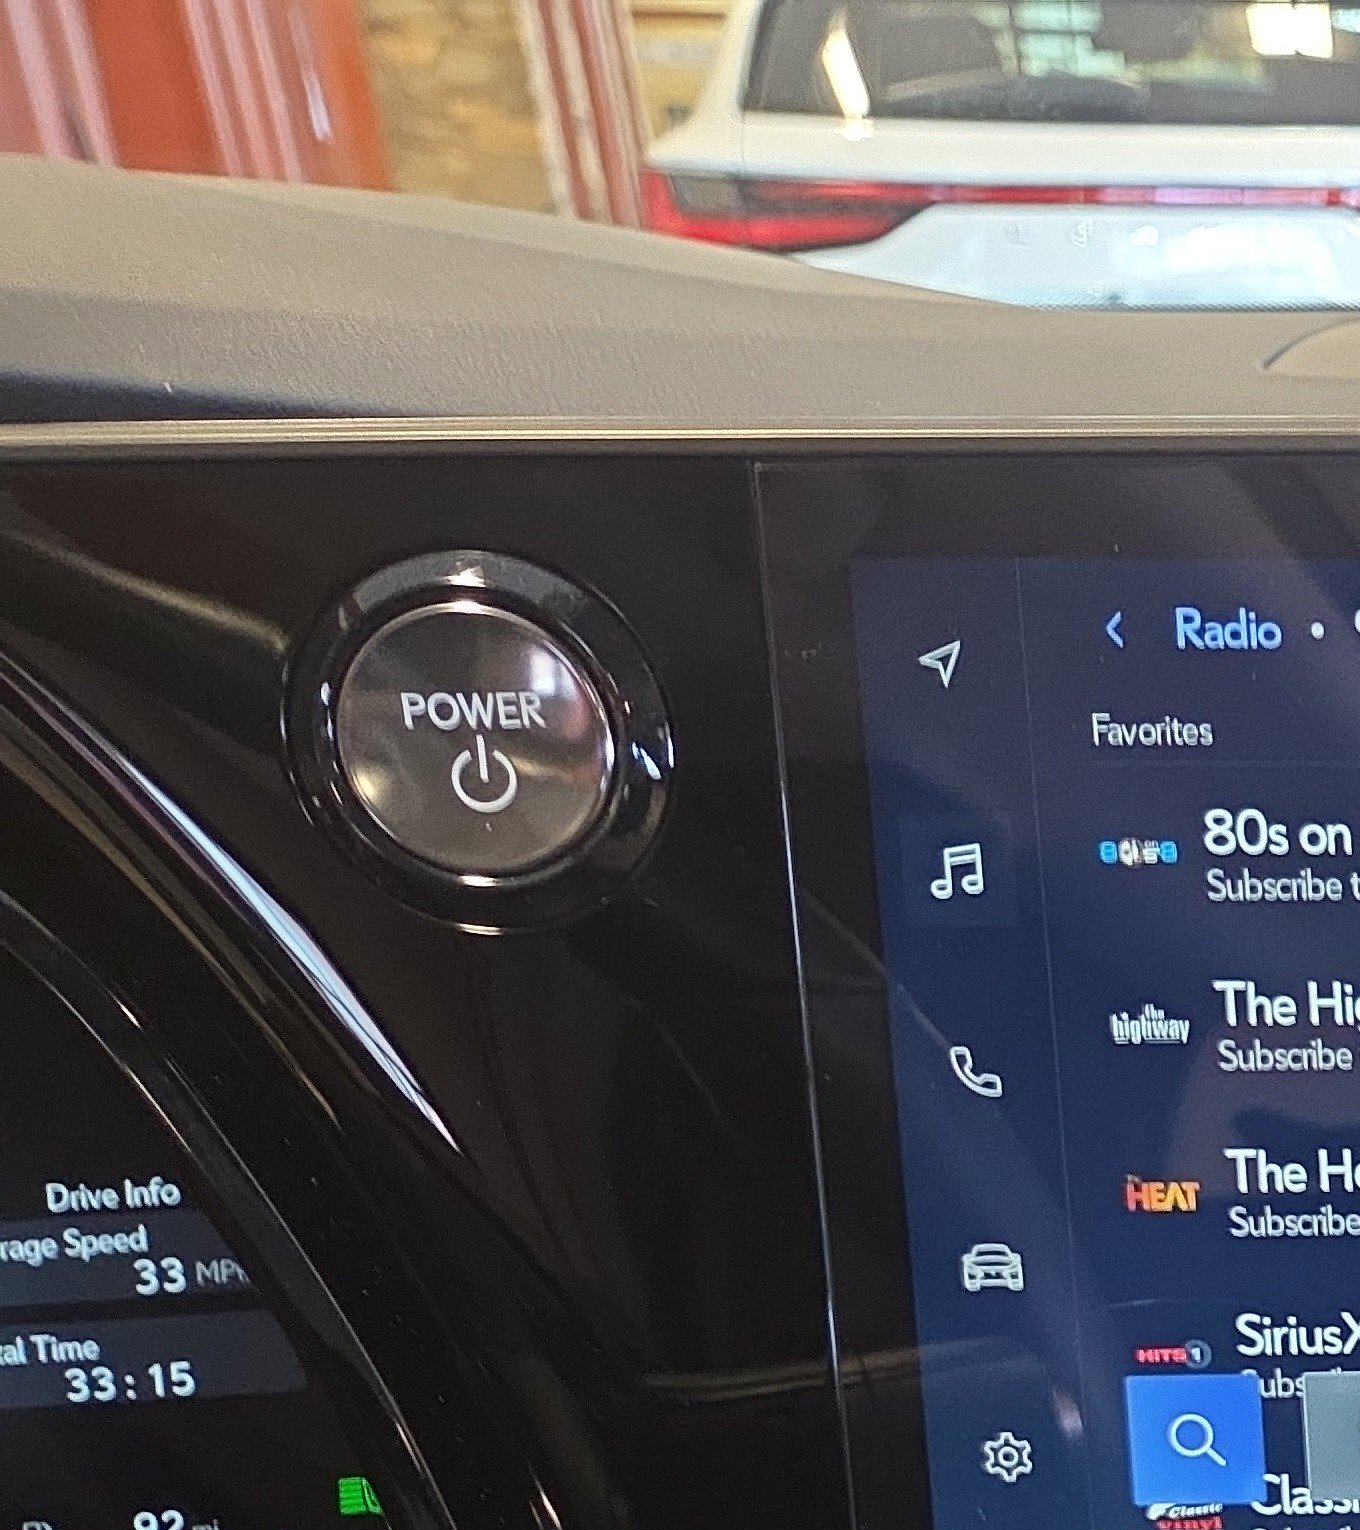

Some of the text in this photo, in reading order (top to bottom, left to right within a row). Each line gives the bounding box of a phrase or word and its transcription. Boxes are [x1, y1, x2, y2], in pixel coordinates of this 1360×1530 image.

[1174, 607, 1283, 650] Radio
[400, 690, 546, 731] POWER
[1092, 713, 1214, 747] Favorites
[1203, 808, 1289, 855] 80s
[1299, 819, 1353, 855] on
[1206, 868, 1343, 903] Subscribe
[1213, 980, 1297, 1027] The
[1110, 1011, 1190, 1044] highway
[1217, 1038, 1354, 1073] Subscribe
[1224, 1148, 1307, 1193] The
[46, 1176, 182, 1214] Drive Info
[1126, 1181, 1200, 1211] HEAT
[62, 1225, 148, 1262] Speed
[134, 1256, 188, 1297] 33
[29, 1334, 100, 1364] Time
[1136, 1348, 1187, 1363] HITS
[65, 1360, 197, 1402] 33:15
